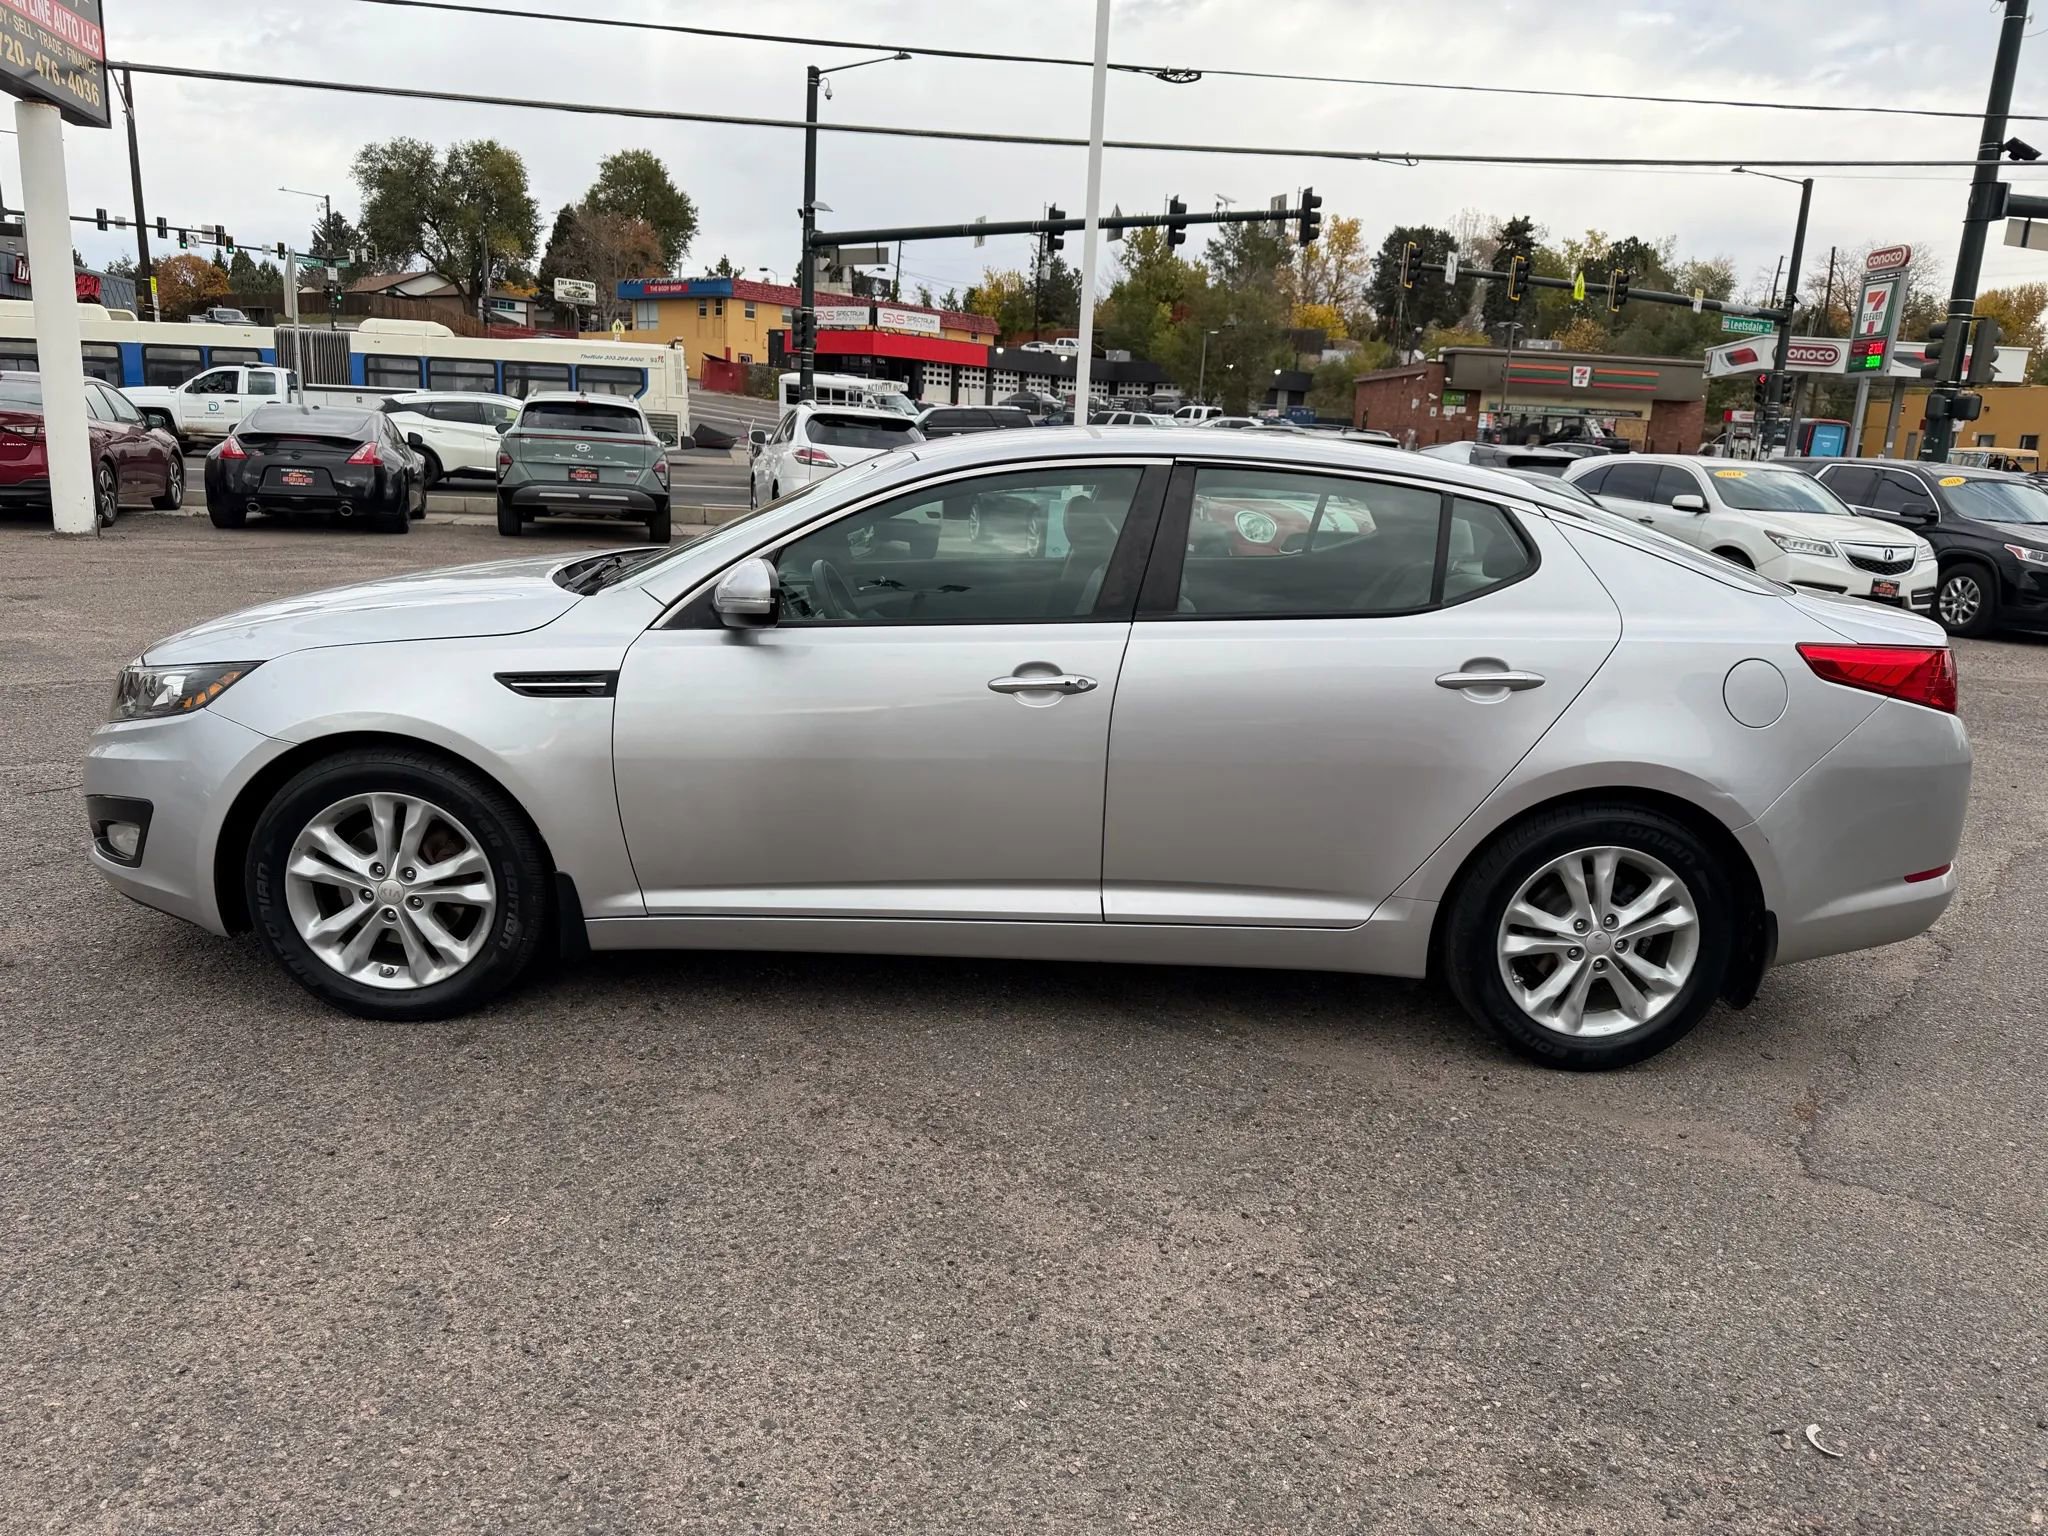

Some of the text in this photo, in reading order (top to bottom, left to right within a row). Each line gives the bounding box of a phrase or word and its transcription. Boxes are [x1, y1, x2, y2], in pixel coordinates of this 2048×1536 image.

[53, 5, 79, 43] AUTO
[80, 22, 99, 55] LLC
[13, 15, 35, 41] SELL
[37, 29, 63, 57] TRADE
[66, 46, 97, 76] FINANCE
[582, 282, 595, 290] SHOP
[906, 315, 936, 324] SPECTRUM
[1730, 320, 1764, 332] Leetsdale
[1787, 348, 1836, 361] onoco
[867, 383, 892, 392] ACTIVITY
[893, 383, 904, 392] BUS
[380, 886, 401, 898] KIA
